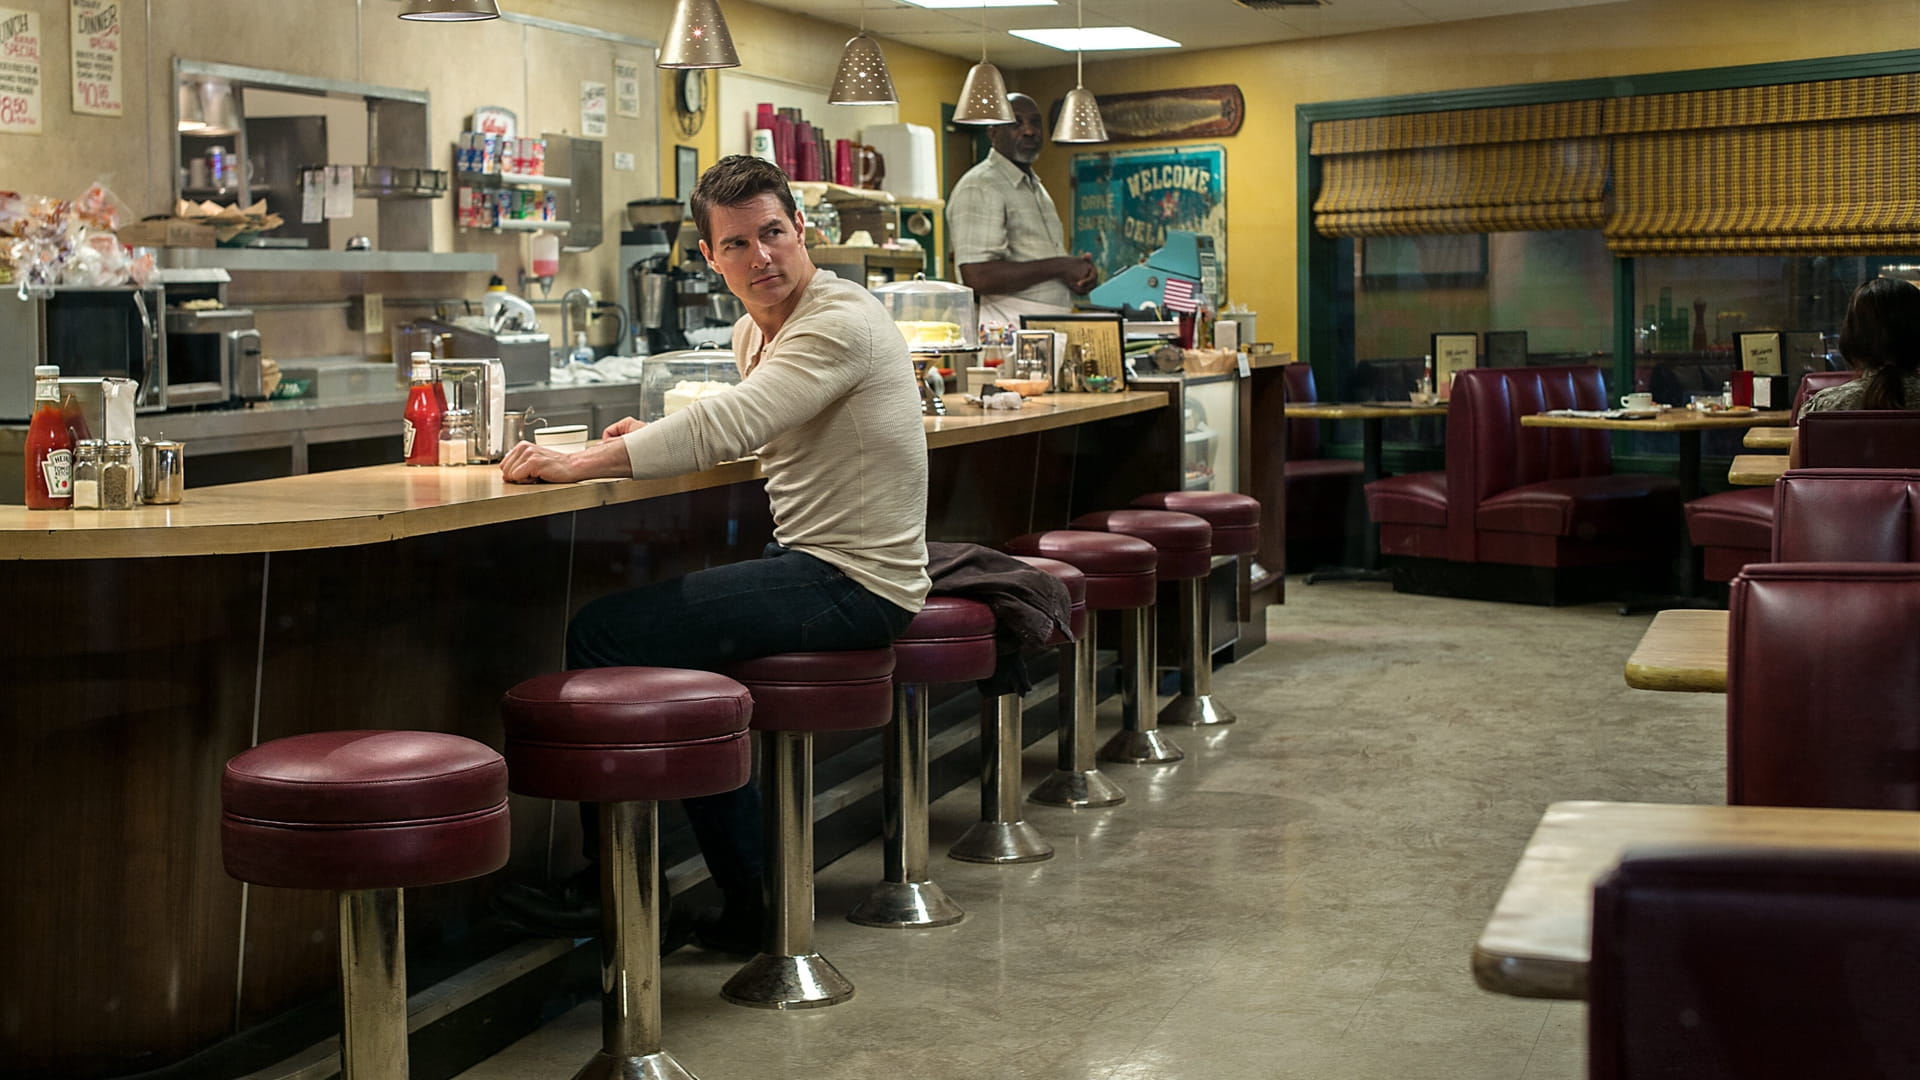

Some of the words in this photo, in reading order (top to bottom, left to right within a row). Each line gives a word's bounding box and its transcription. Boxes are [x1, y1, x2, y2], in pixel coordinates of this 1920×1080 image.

[0, 13, 29, 43] UNCH
[78, 4, 118, 34] DINNER
[1126, 165, 1210, 198] WELCOME
